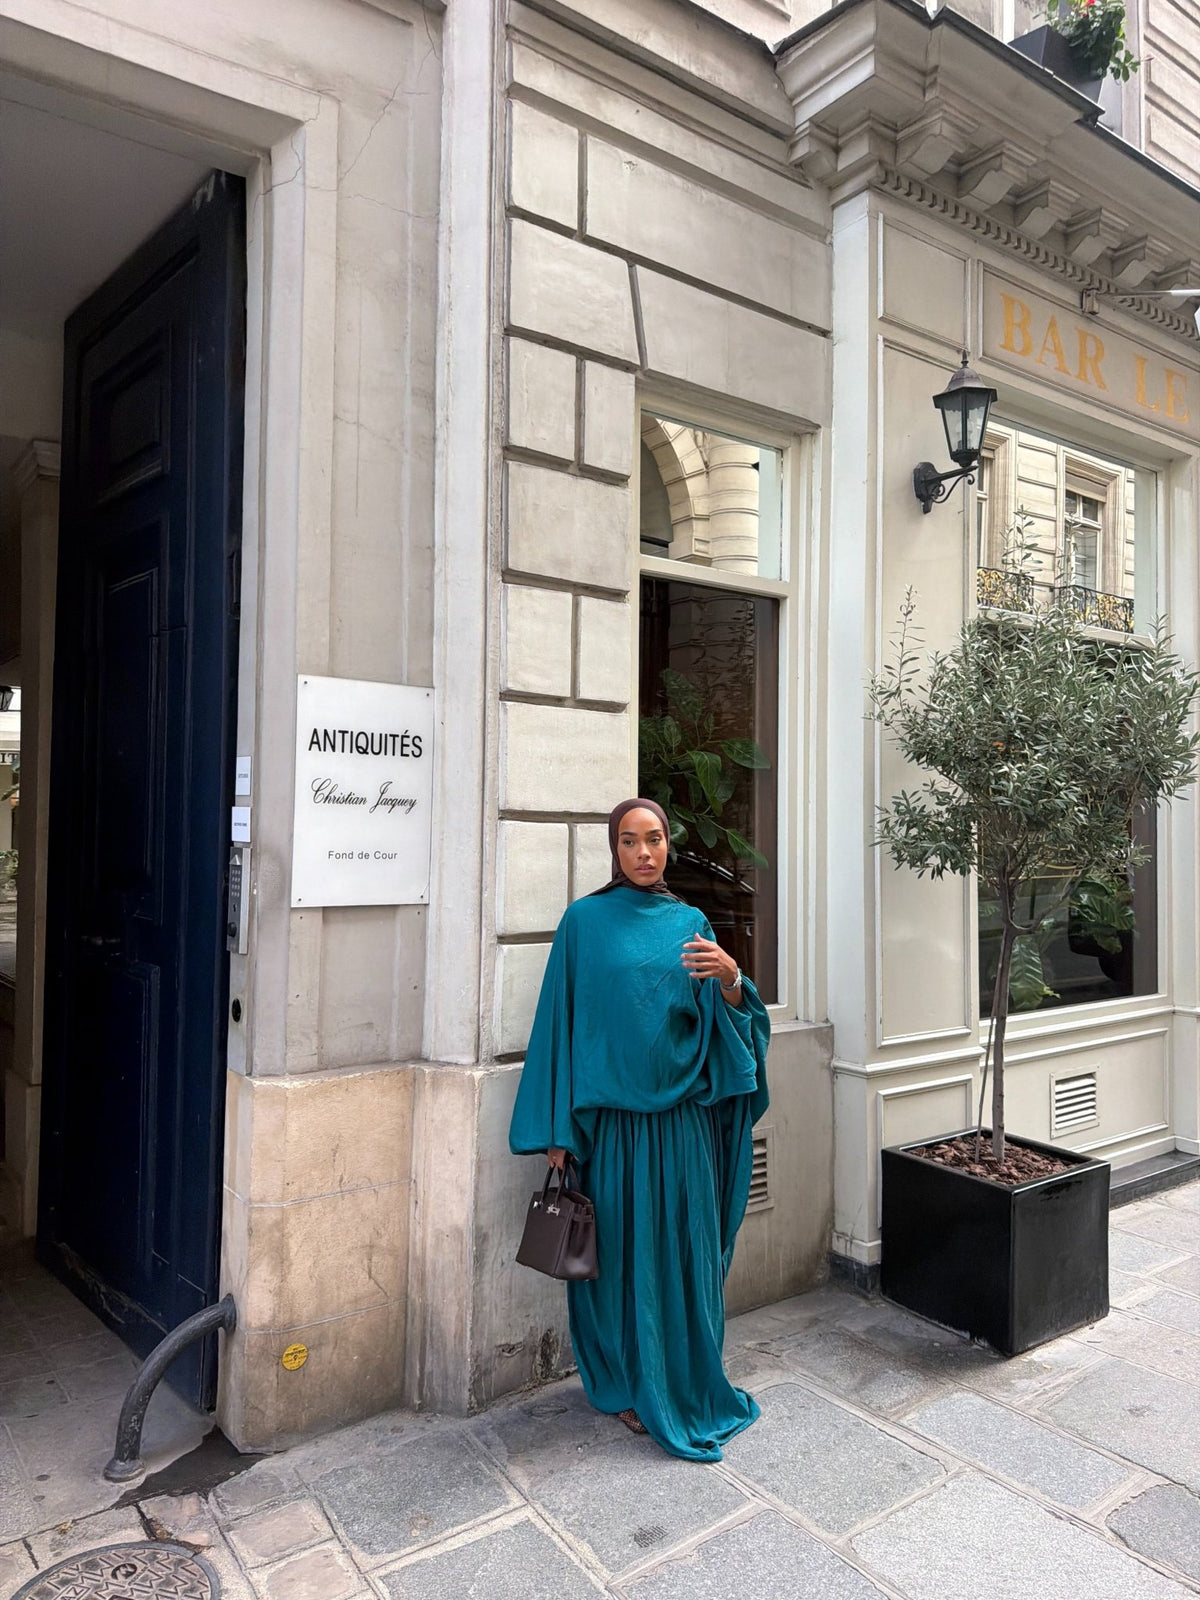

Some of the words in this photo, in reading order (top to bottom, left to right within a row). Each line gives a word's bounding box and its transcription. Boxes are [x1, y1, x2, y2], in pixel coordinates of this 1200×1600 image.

[1000, 291, 1109, 392] BAR
[1134, 354, 1190, 424] LE
[308, 728, 422, 758] ANTIQUITÉS
[311, 778, 368, 806] Christian
[368, 781, 418, 815] Jacquey
[328, 850, 354, 860] Fond
[357, 850, 370, 860] de
[374, 850, 398, 860] Cour
